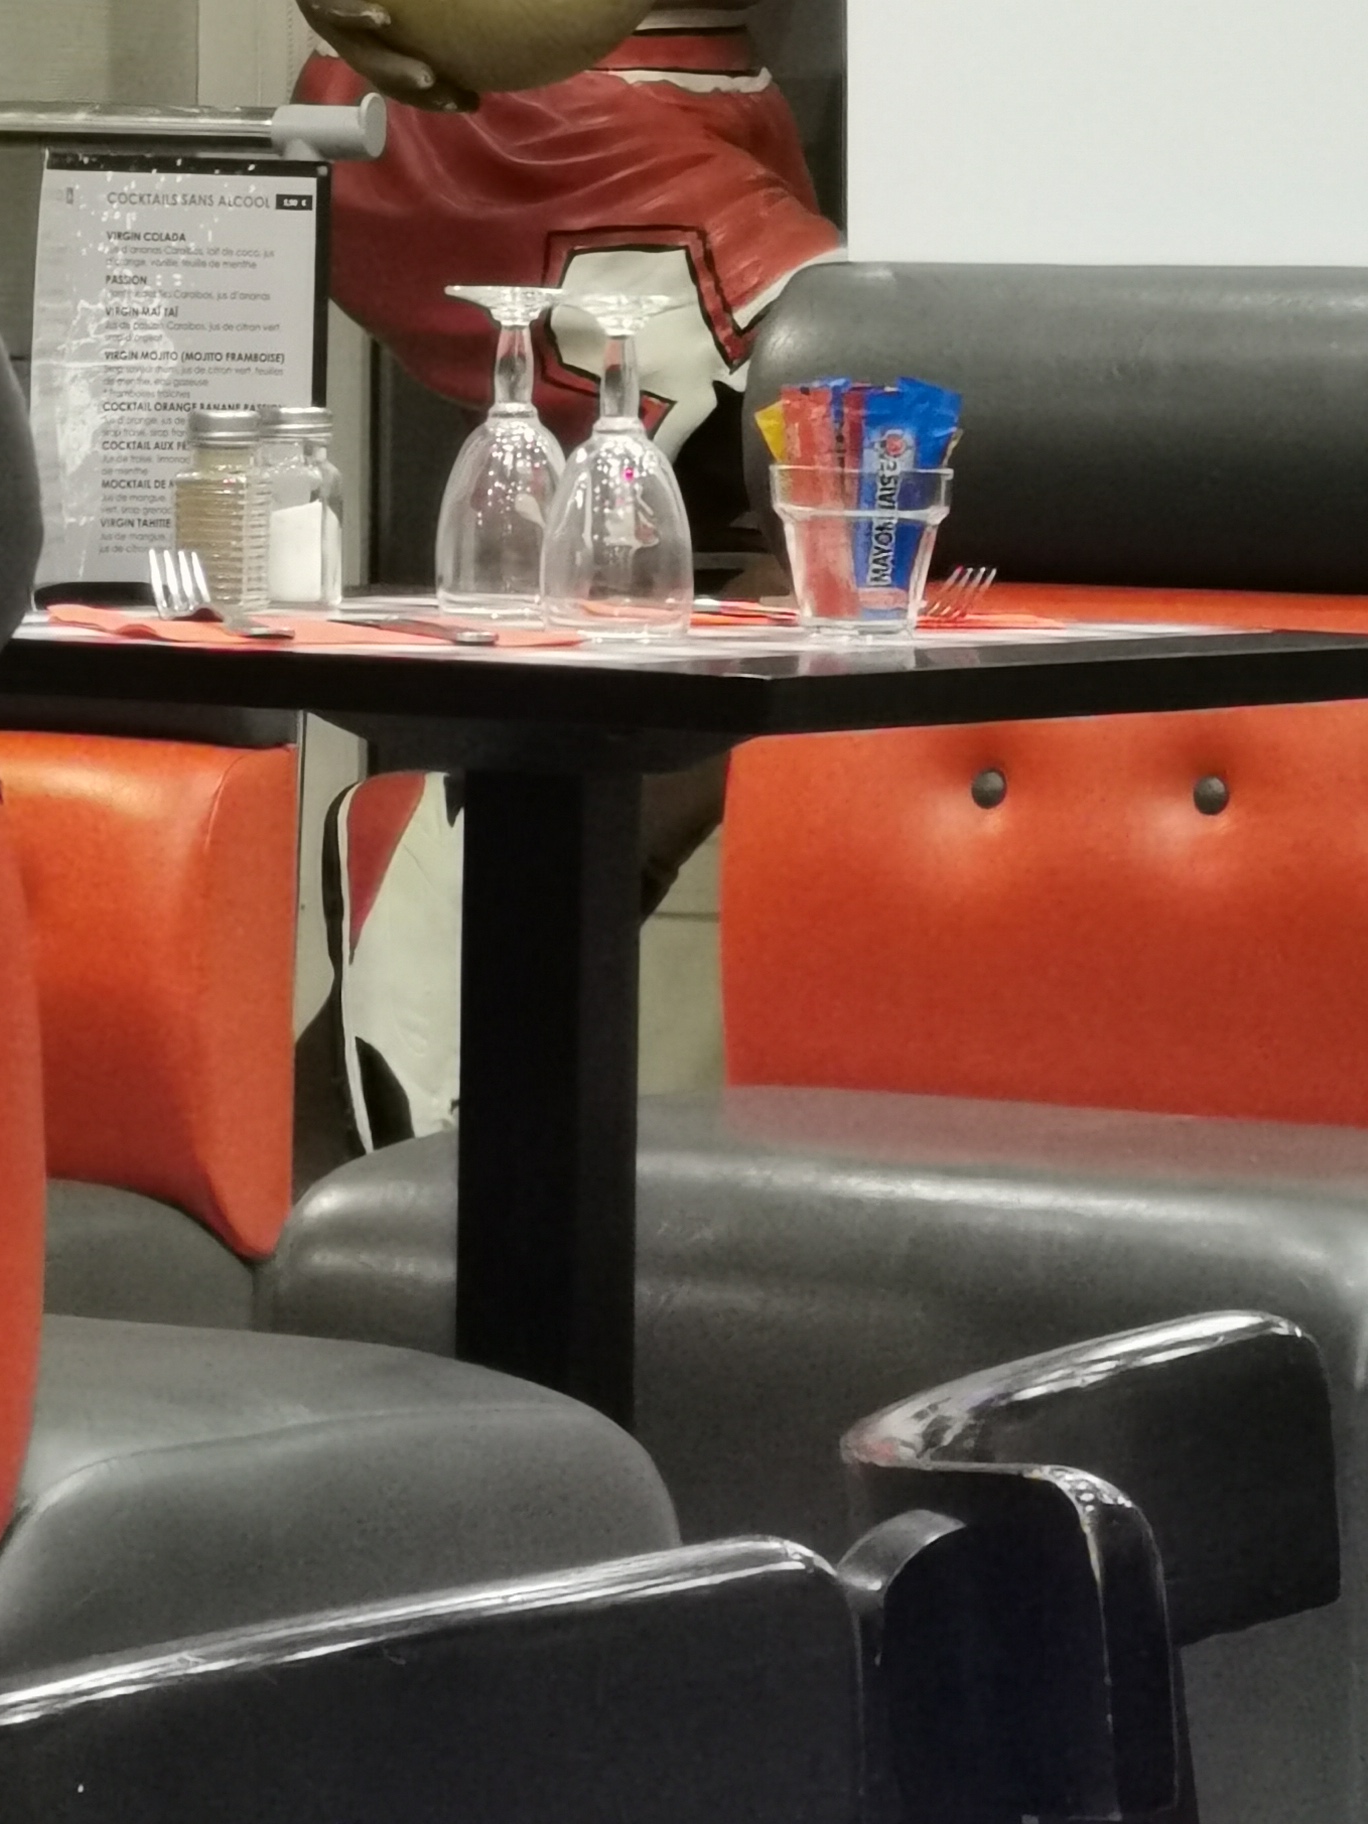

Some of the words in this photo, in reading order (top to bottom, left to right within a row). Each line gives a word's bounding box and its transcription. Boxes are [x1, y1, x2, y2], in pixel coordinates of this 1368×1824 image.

[107, 191, 179, 206] COCKTAILS
[181, 193, 215, 207] SANS
[218, 193, 271, 209] ALCOOL
[106, 231, 142, 242] VIRGIN
[143, 232, 187, 242] COLADA
[104, 350, 139, 361] VIRGIN
[140, 351, 178, 362] MOJITO
[181, 351, 223, 363] (MOJITO
[225, 352, 285, 365] FRAMBOISE)
[102, 402, 153, 412] COCKTAIL
[153, 402, 197, 413] ORANGE
[101, 441, 153, 451] COCKTAIL
[153, 441, 174, 451] AUX
[101, 479, 152, 490] MOCKTAIL
[153, 479, 166, 490] DE
[100, 518, 135, 528] VIRGIN
